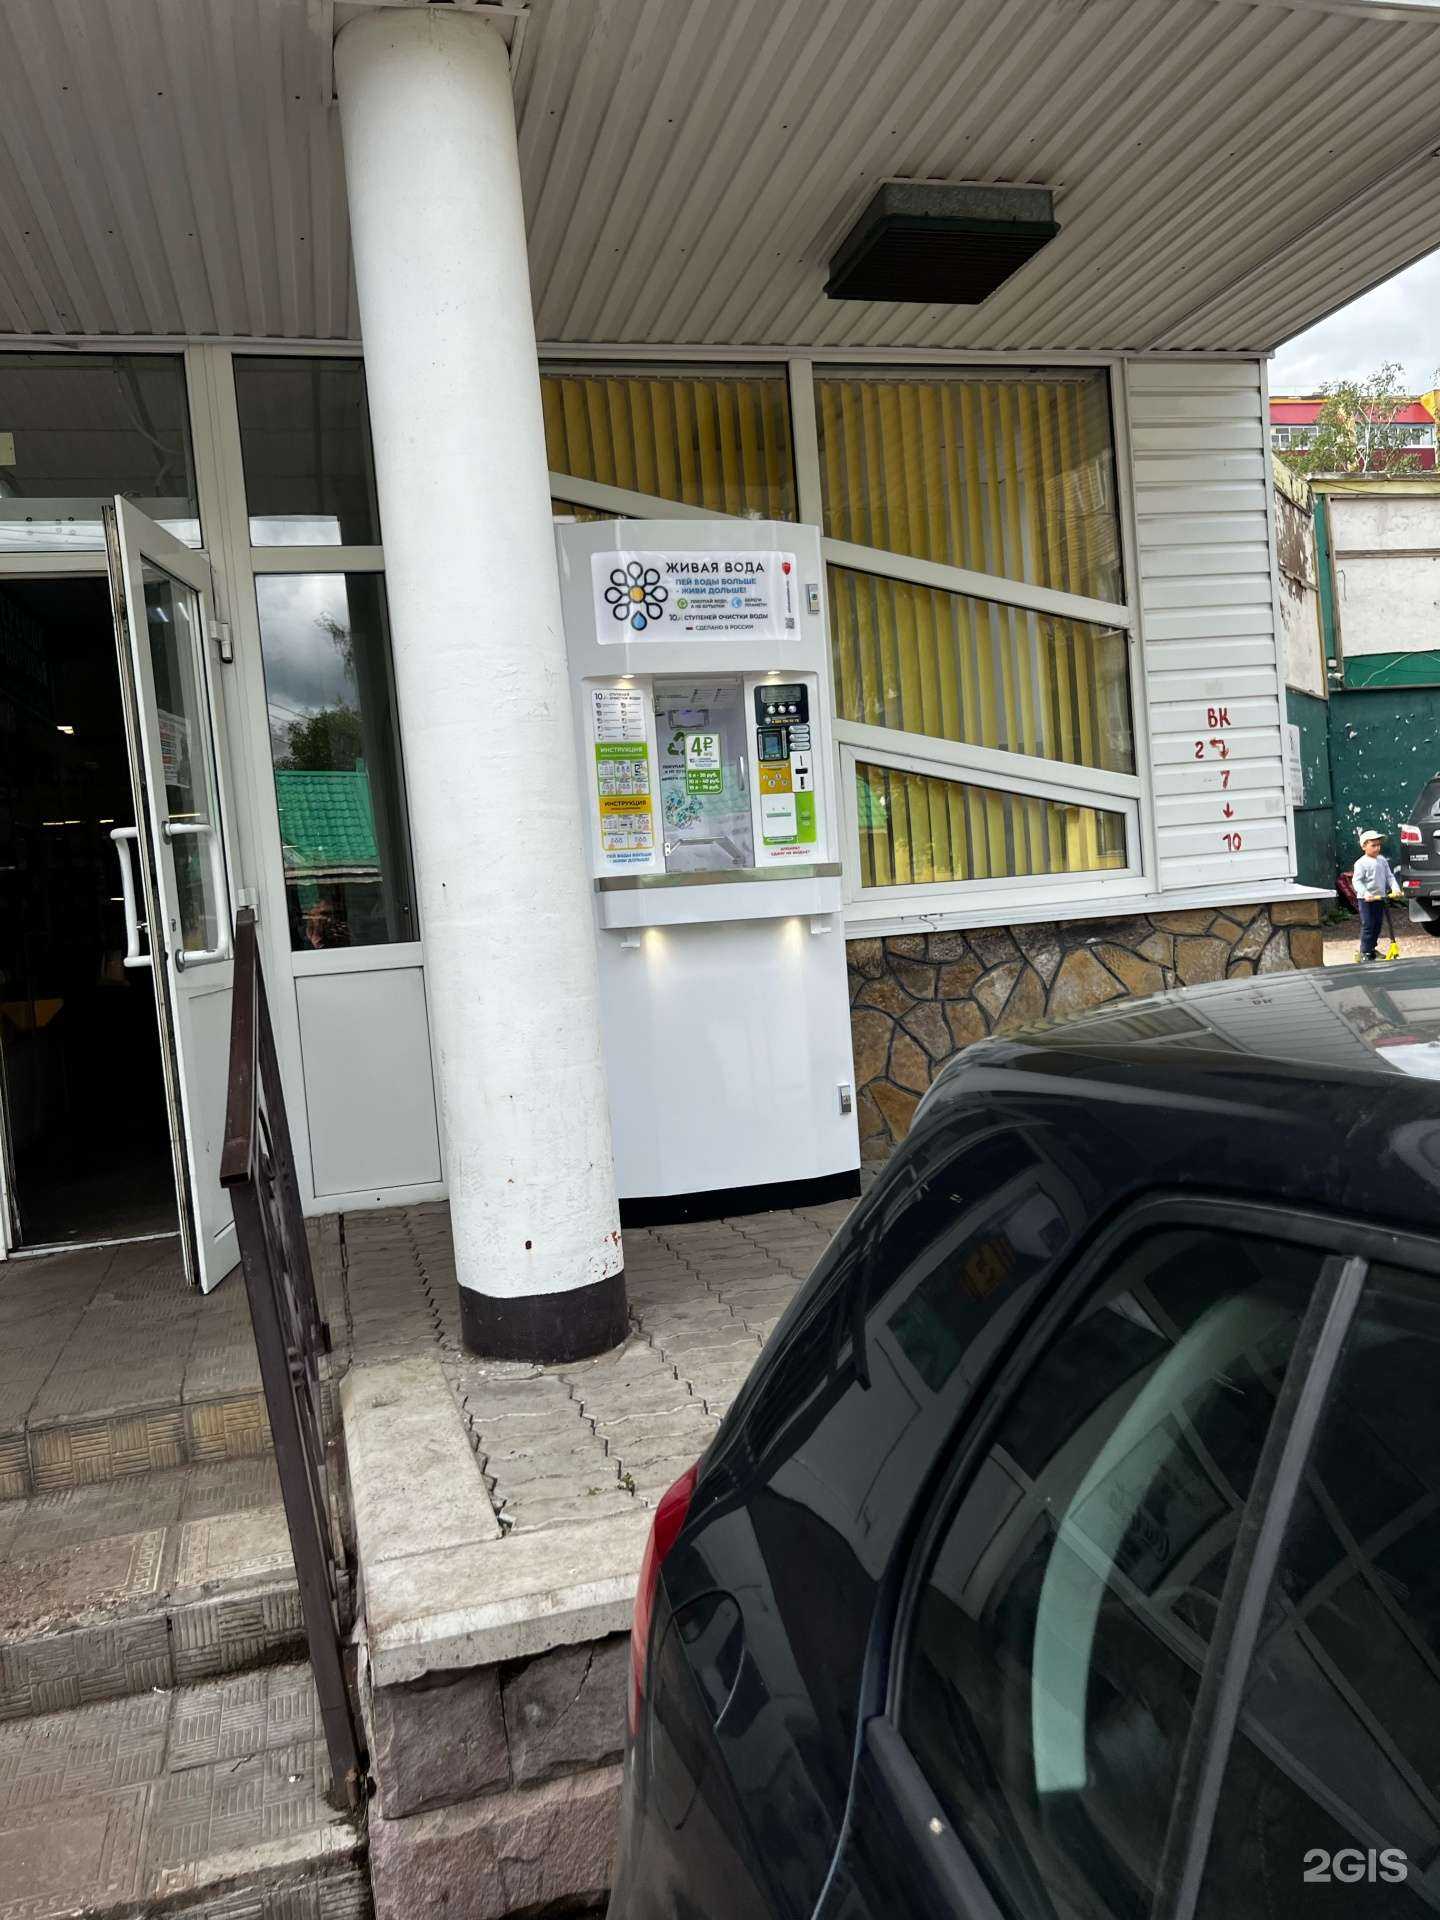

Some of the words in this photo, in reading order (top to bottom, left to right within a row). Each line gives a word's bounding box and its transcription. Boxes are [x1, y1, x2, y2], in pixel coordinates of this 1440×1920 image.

[666, 562, 719, 573] ЖИВАЯ
[725, 562, 765, 574] ВОДА
[676, 578, 692, 586] ПЕЙ
[695, 578, 719, 586] ВОДЫ
[721, 577, 757, 585] БОЛЬШЕ
[1195, 741, 1204, 759] 2
[1220, 770, 1230, 789] 7
[1223, 833, 1242, 852] 10
